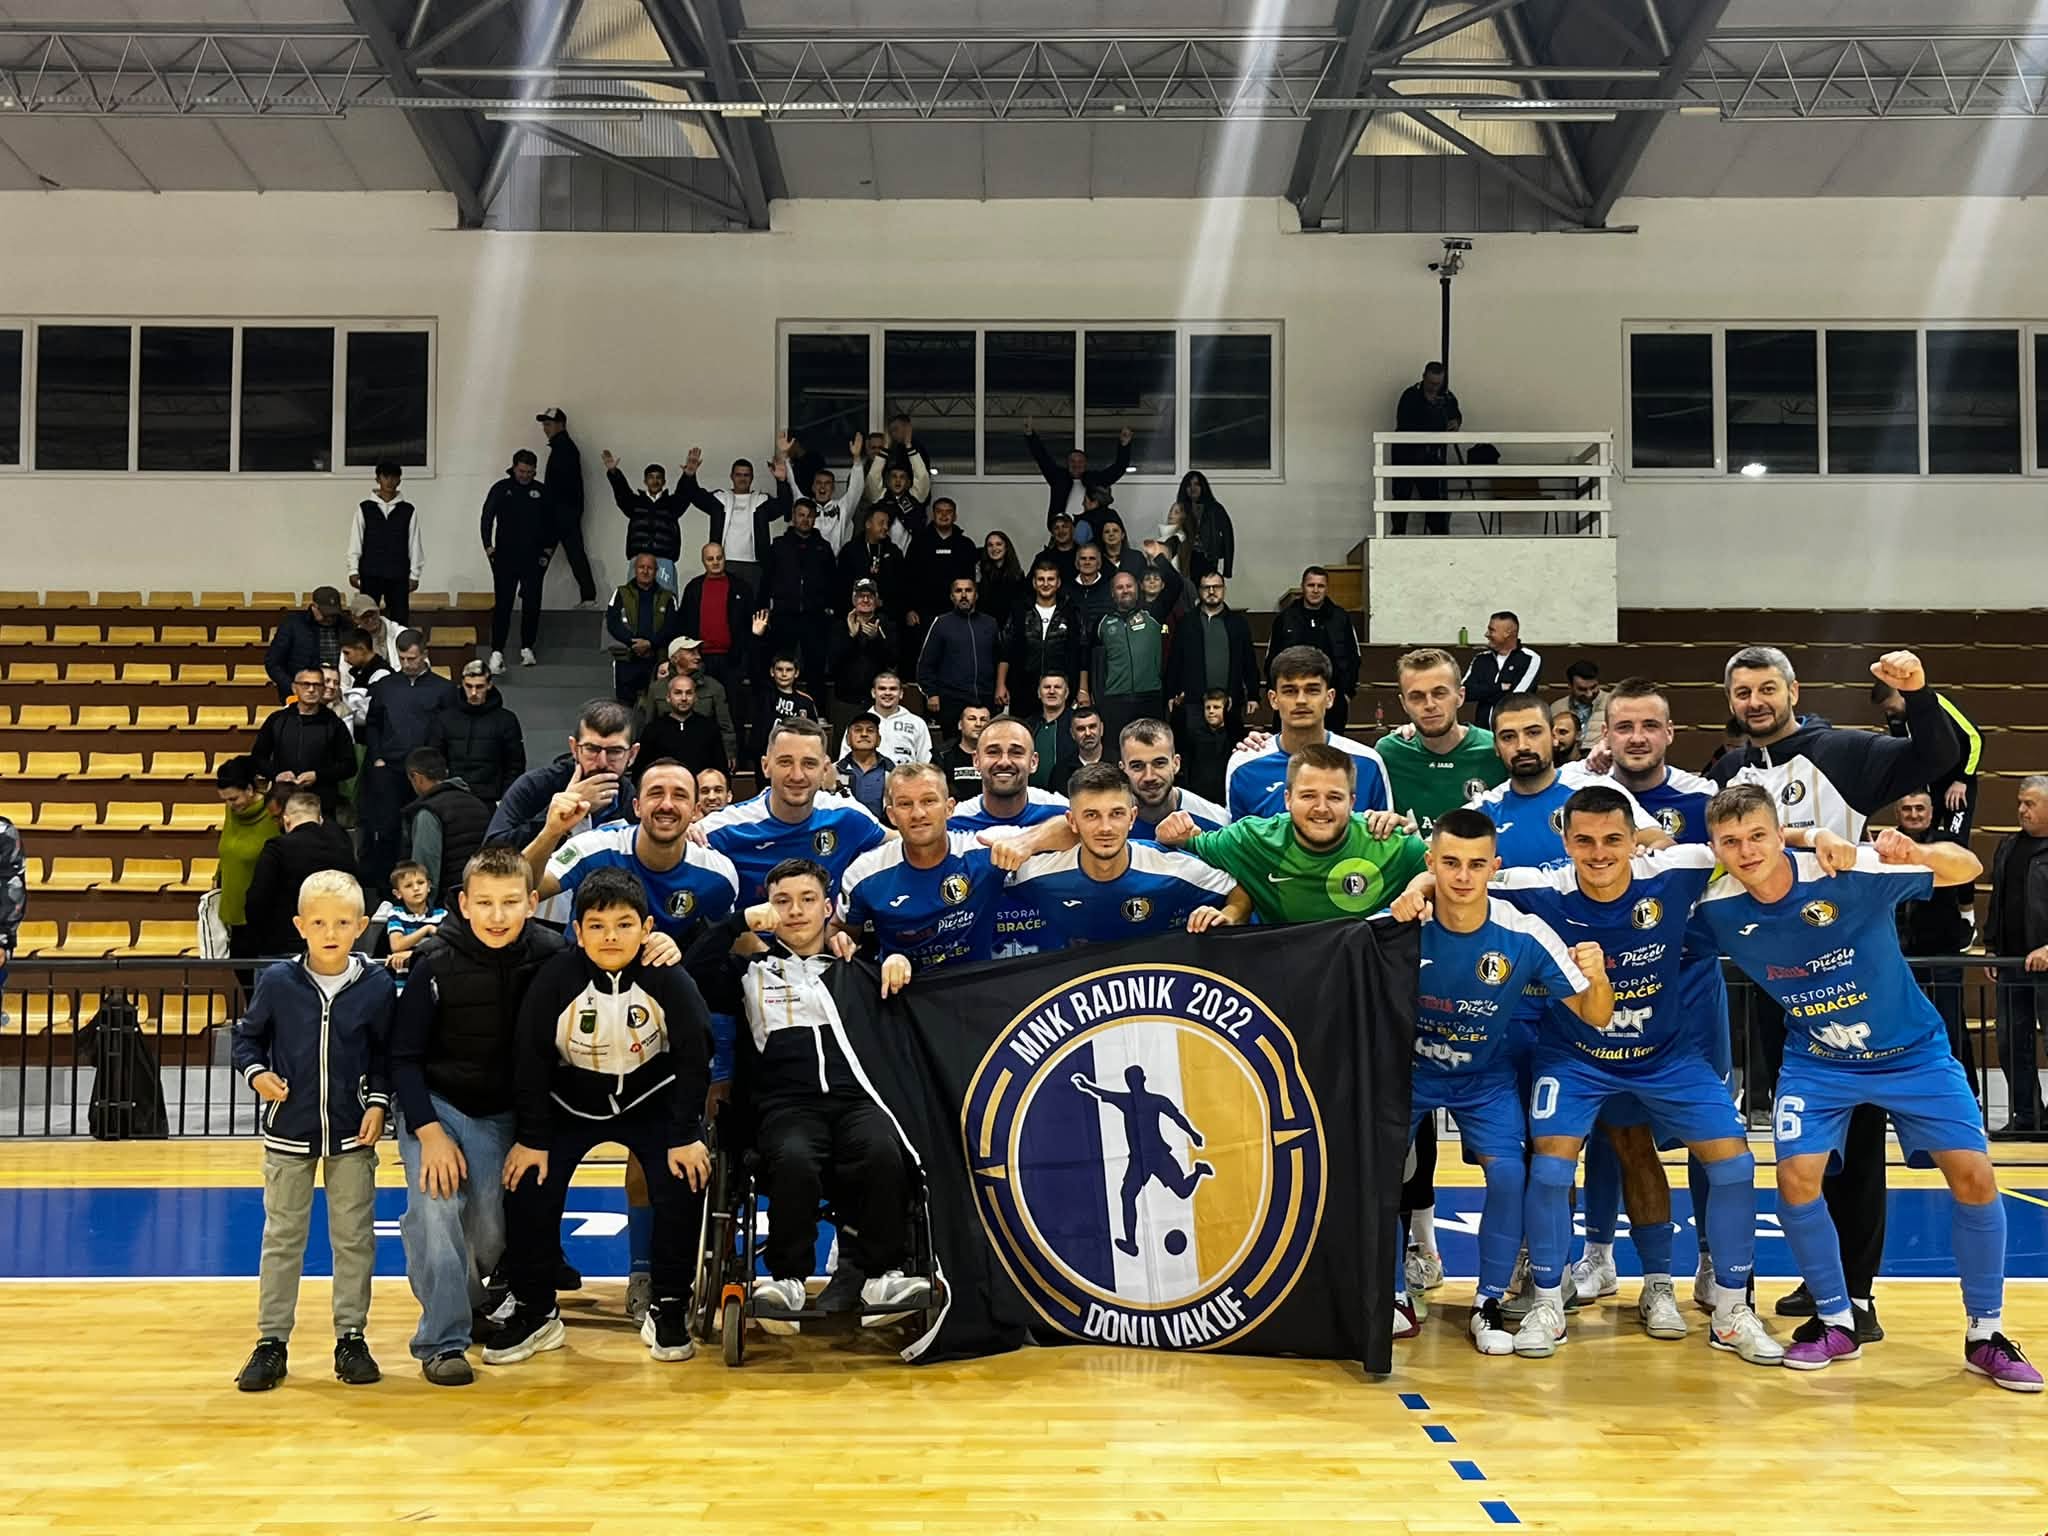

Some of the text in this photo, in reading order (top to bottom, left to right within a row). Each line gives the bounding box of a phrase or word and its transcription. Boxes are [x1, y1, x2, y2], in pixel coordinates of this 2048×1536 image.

[997, 909, 1039, 920] STORA
[1806, 948, 1855, 973] Piccolo
[1611, 972, 1657, 989] TORAN
[1614, 982, 1663, 1001] RAĆE«
[1009, 976, 1253, 1066] MNK RADNIK 2022
[1531, 1076, 1560, 1119] 0
[1774, 1095, 1805, 1141] 6
[1084, 1286, 1246, 1347] DONJI VAKUF
